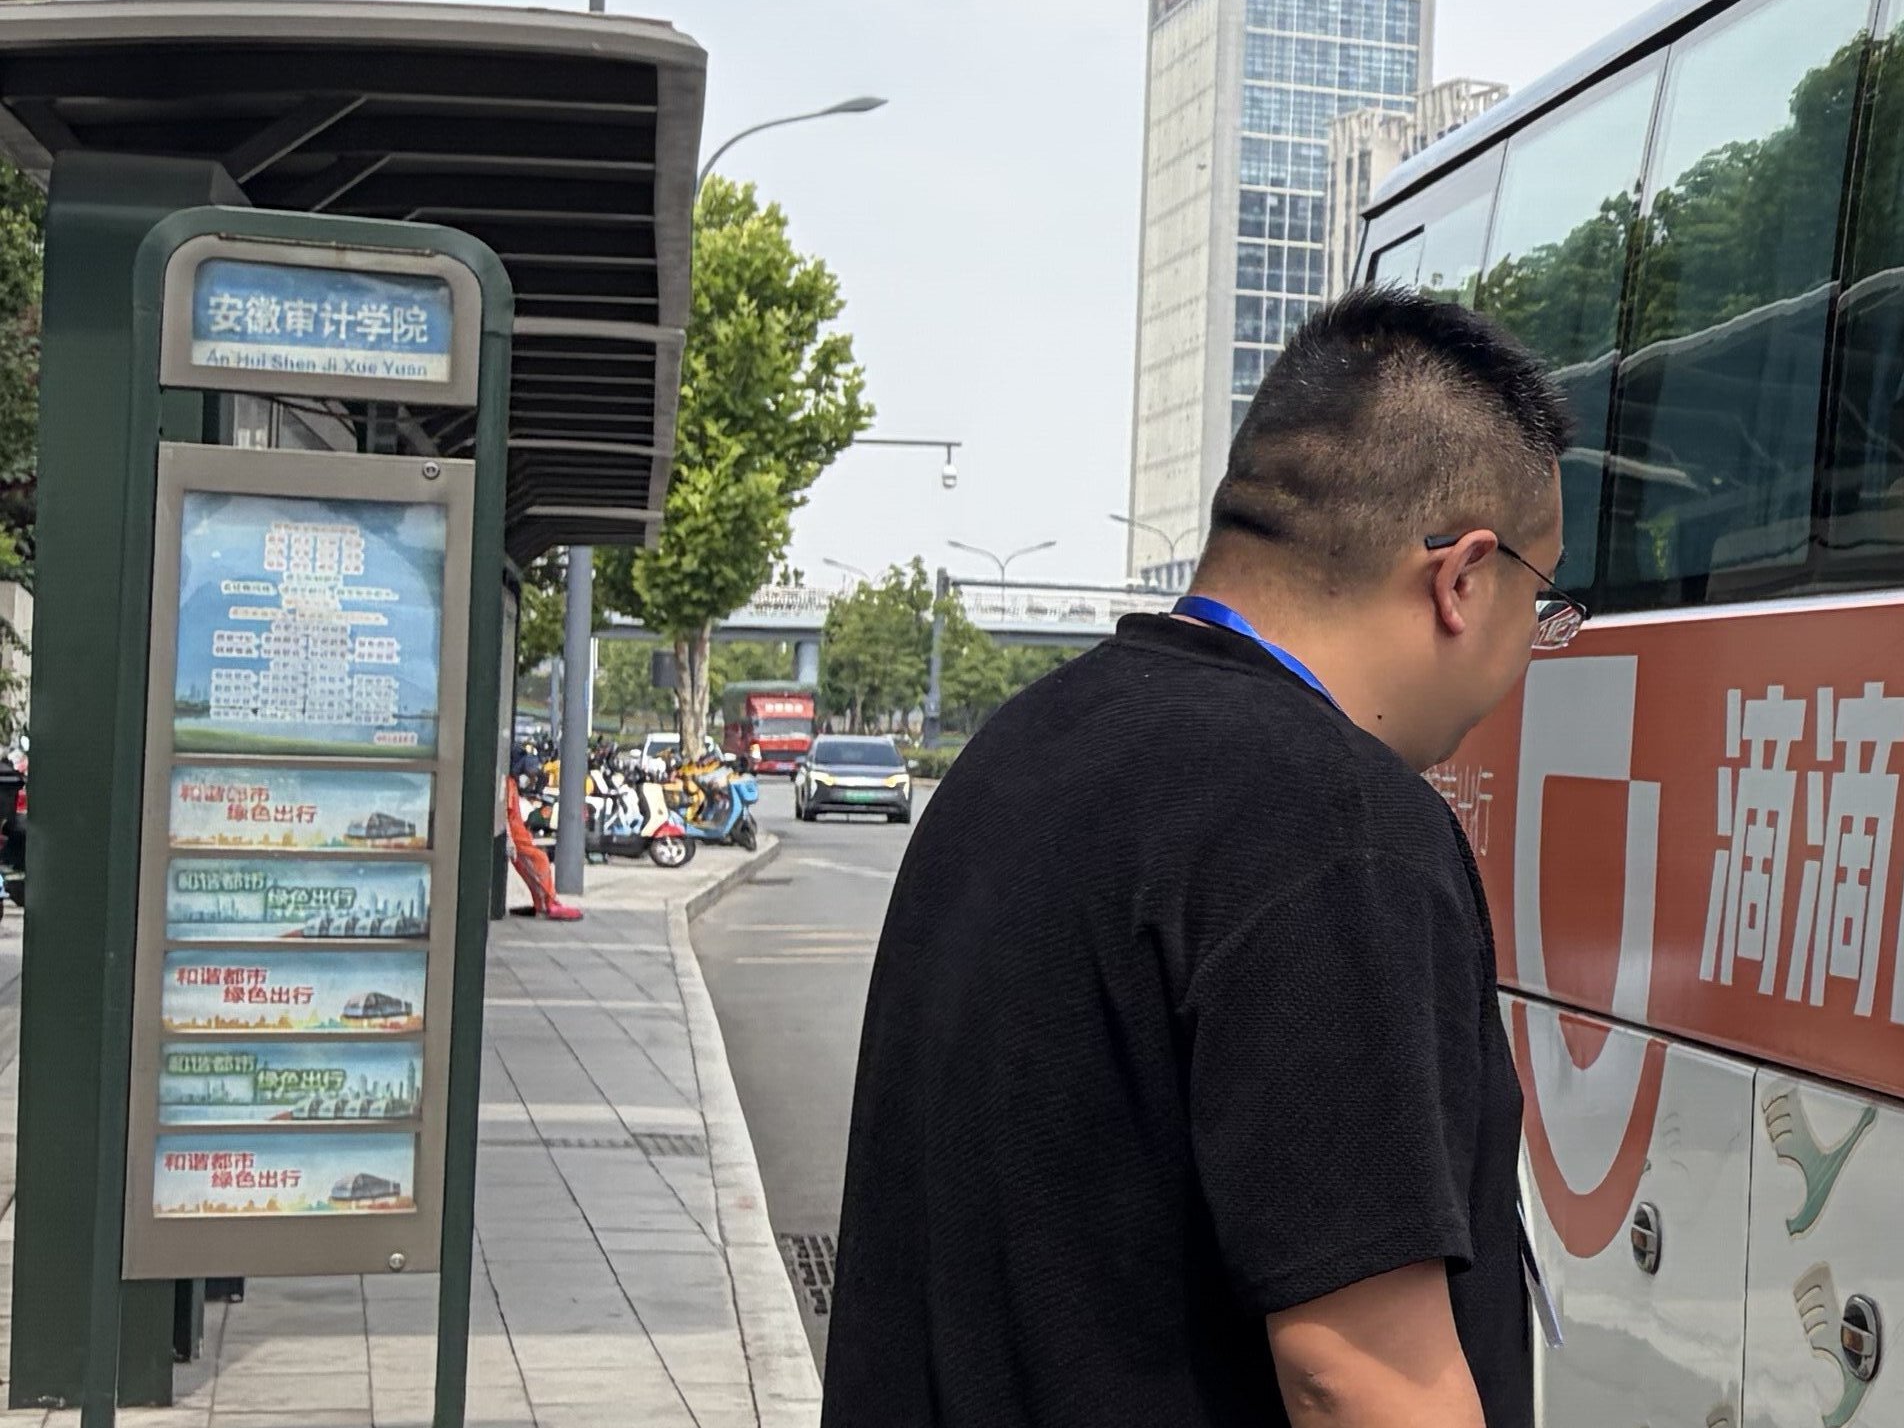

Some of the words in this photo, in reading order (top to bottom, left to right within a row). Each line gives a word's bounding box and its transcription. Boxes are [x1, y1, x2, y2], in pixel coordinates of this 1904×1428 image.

[207, 292, 429, 344] 安徽审计学院
[206, 348, 231, 365] An
[272, 353, 317, 371] Shen
[322, 356, 338, 373] Ji
[343, 358, 377, 374] Xue
[382, 359, 428, 377] Yuan
[226, 803, 317, 824] 绿色出行
[267, 887, 355, 910] 绿色出行
[175, 966, 269, 986] 和谐都市
[222, 985, 315, 1005] 绿色出行
[167, 1054, 256, 1074] 和谐都市
[257, 1070, 345, 1091] 绿色出行
[164, 1151, 256, 1172] 和谐都市
[210, 1169, 302, 1190] 绿色出行
